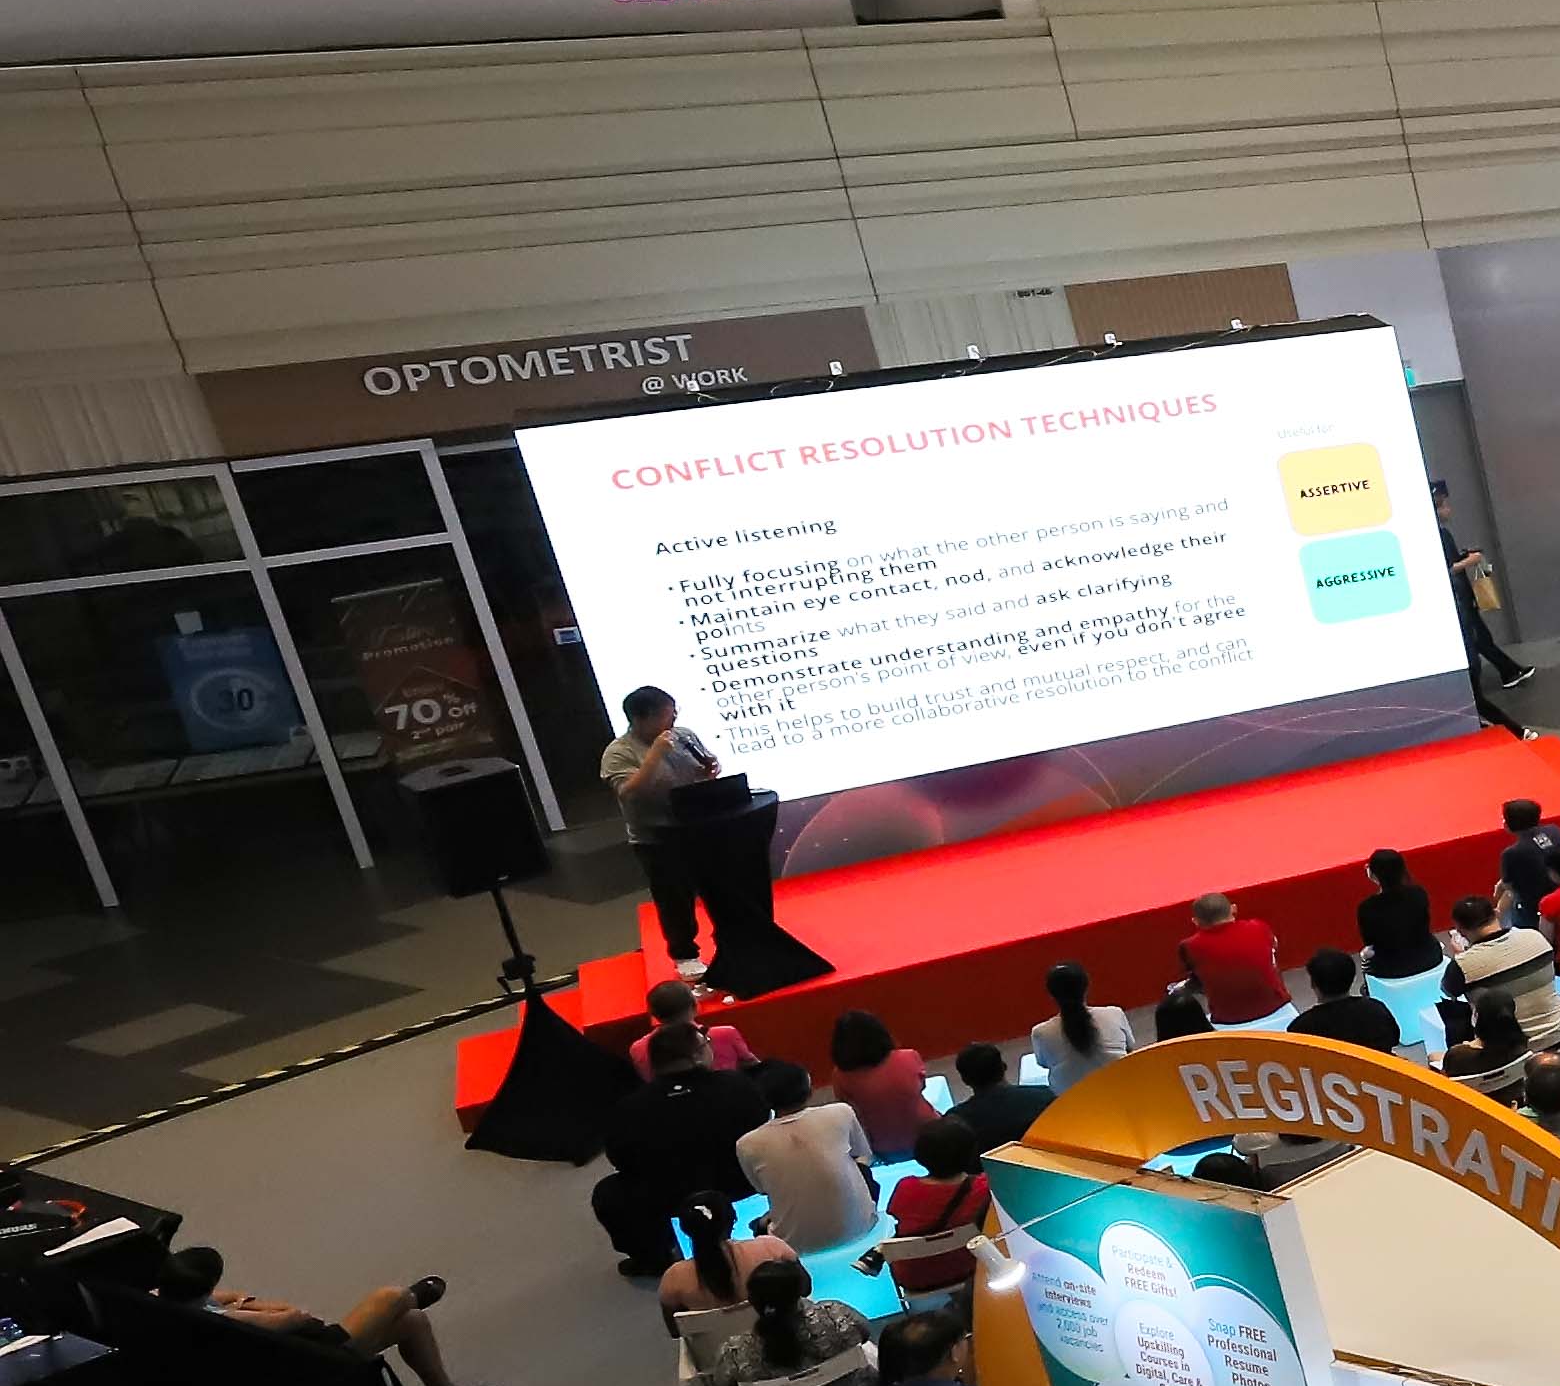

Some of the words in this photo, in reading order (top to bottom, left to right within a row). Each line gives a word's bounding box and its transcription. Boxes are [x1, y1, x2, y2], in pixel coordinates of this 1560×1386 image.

[362, 331, 695, 401] OPTOMETRIST
[641, 375, 667, 397] @
[669, 362, 749, 392] WORK
[611, 449, 785, 489] CONFLICT
[799, 420, 1012, 465] RESOLUTION
[1020, 394, 1217, 435] TECHNIQUES
[1300, 479, 1370, 499] ASSERTIVE
[656, 536, 728, 555] Active
[735, 521, 837, 543] listening
[679, 575, 735, 593] Fully
[743, 559, 842, 583] focusing
[847, 554, 872, 568] on
[880, 546, 930, 562] what
[936, 537, 969, 553] the
[976, 530, 1028, 549] other
[1036, 518, 1104, 542] person
[1109, 514, 1125, 528] is
[1129, 505, 1189, 526] saying
[1194, 498, 1229, 516] and
[1315, 566, 1396, 589] AGGRESSIVE
[1208, 1318, 1236, 1336] Snap
[1239, 1325, 1266, 1342] FREE
[1137, 1336, 1184, 1358] Upskilling
[1208, 1335, 1277, 1361] Professional
[1225, 1354, 1268, 1376] Resume
